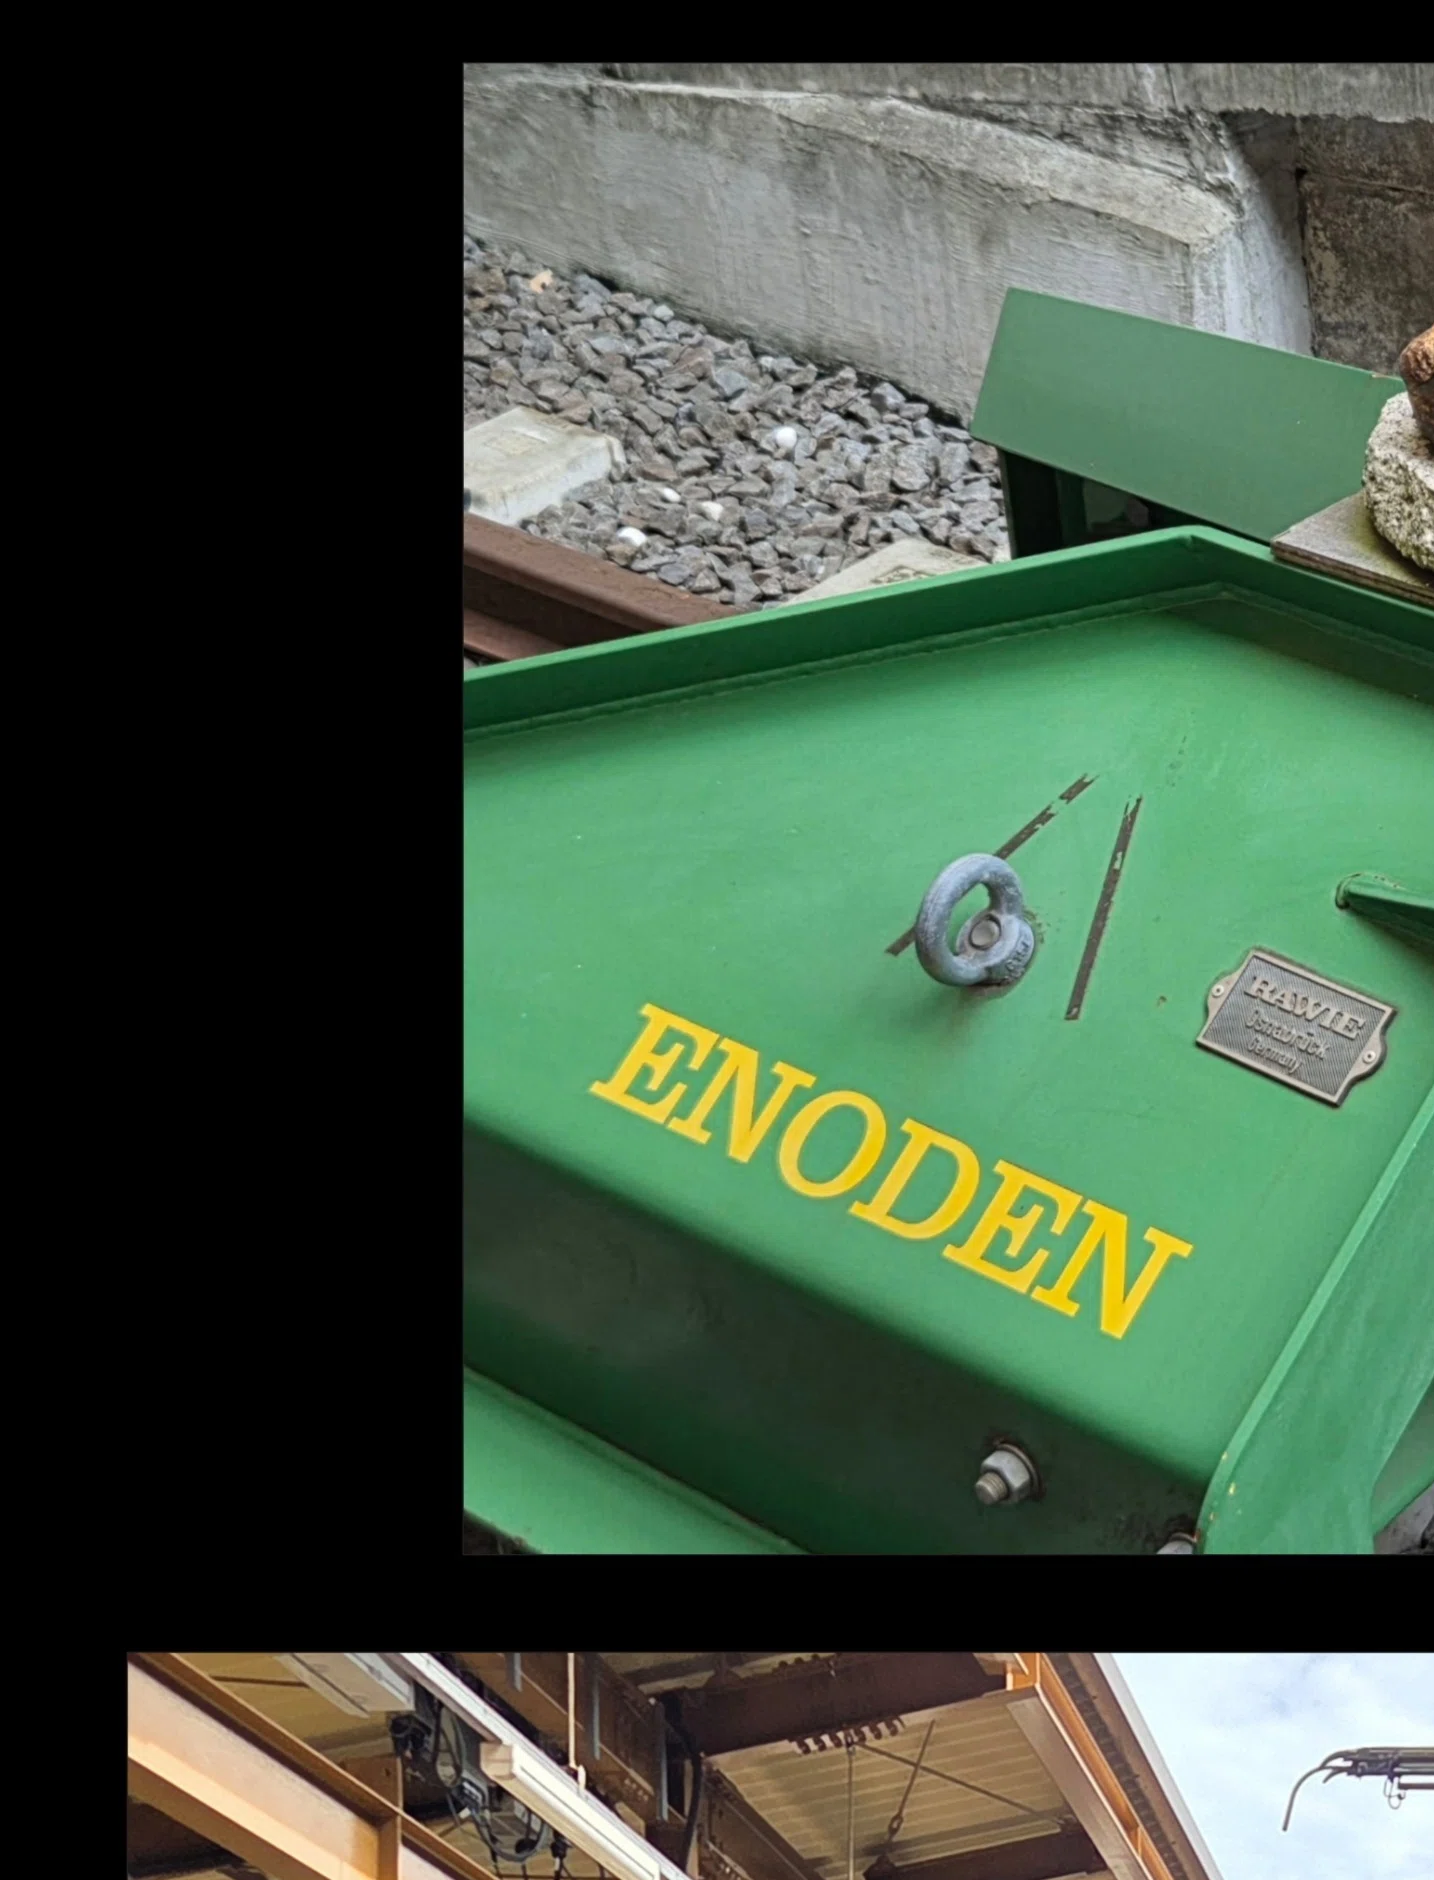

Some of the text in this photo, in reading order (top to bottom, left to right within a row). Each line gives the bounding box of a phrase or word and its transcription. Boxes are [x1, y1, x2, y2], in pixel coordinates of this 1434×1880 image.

[1244, 976, 1366, 1040] RAWIE
[1247, 1037, 1303, 1073] Germany
[589, 1002, 1194, 1340] ENODEN
